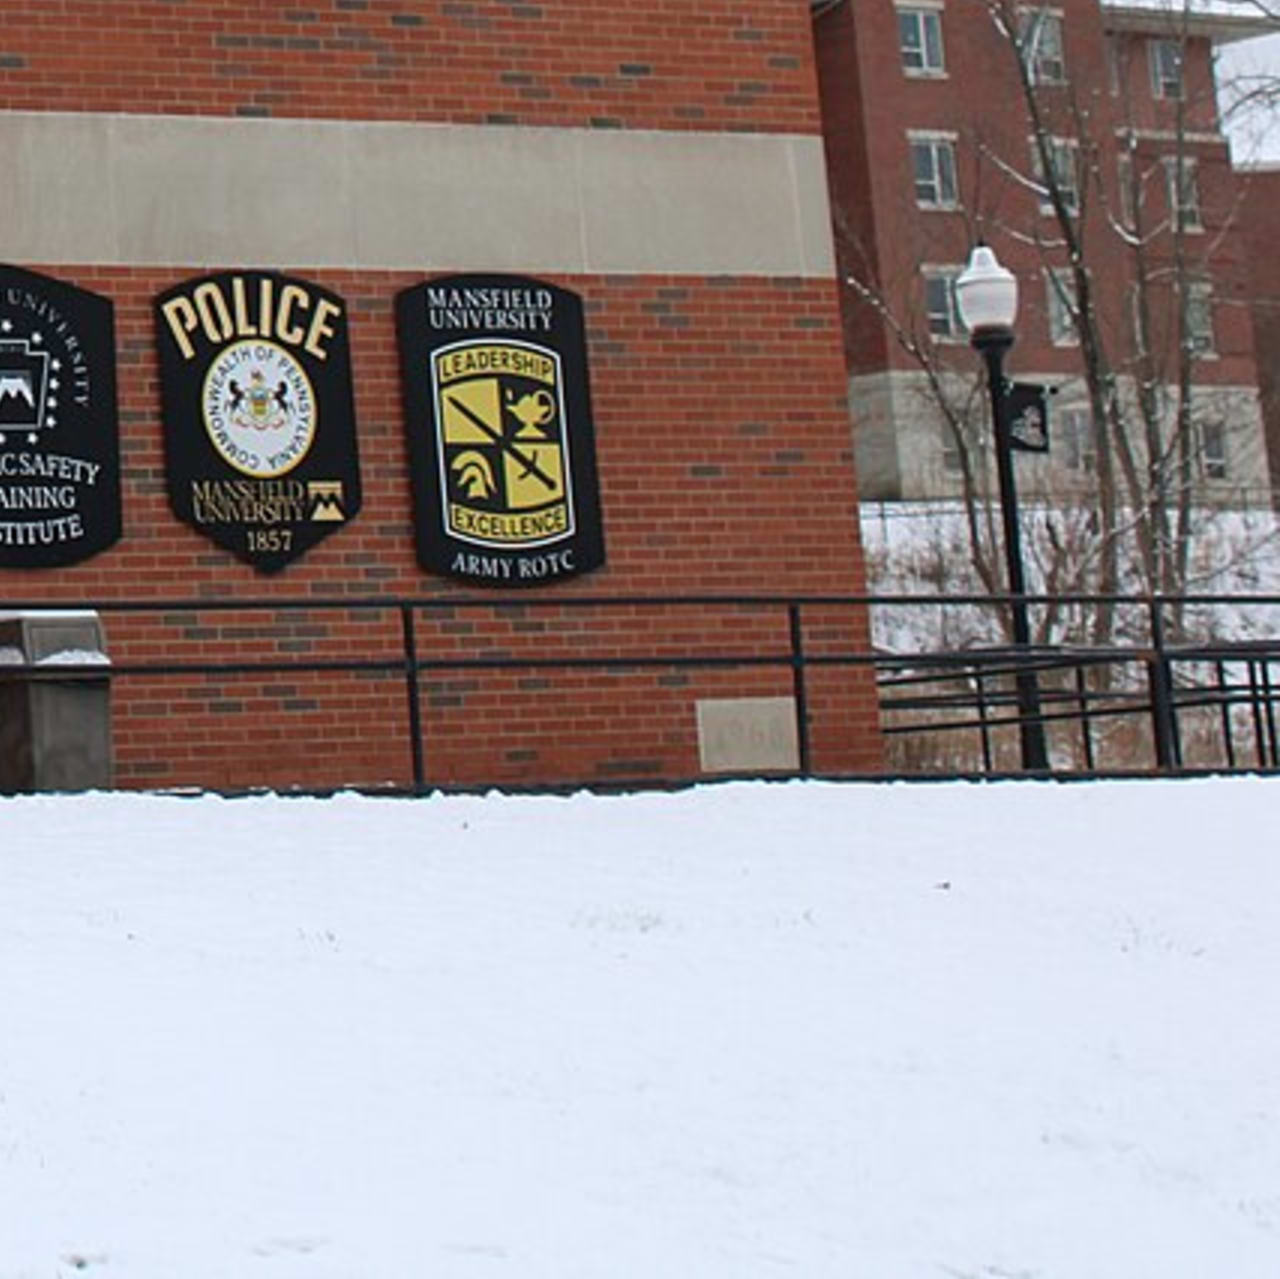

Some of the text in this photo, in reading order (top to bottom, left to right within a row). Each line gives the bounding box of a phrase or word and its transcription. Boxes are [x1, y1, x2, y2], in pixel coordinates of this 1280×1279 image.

[427, 288, 553, 310] MANSFIELD
[162, 277, 340, 360] POLICE
[429, 309, 553, 331] UNIVERSITY
[7, 289, 88, 407] UNIVERSITY
[442, 348, 553, 378] LEADERSHIP
[19, 453, 100, 486] SAFETY
[192, 480, 304, 500] MANSFIELD
[193, 499, 304, 523] UNIVERSITY
[453, 509, 564, 536] EXCELLENCE
[247, 531, 292, 551] 1857
[452, 550, 576, 578] ARMY ROTC
